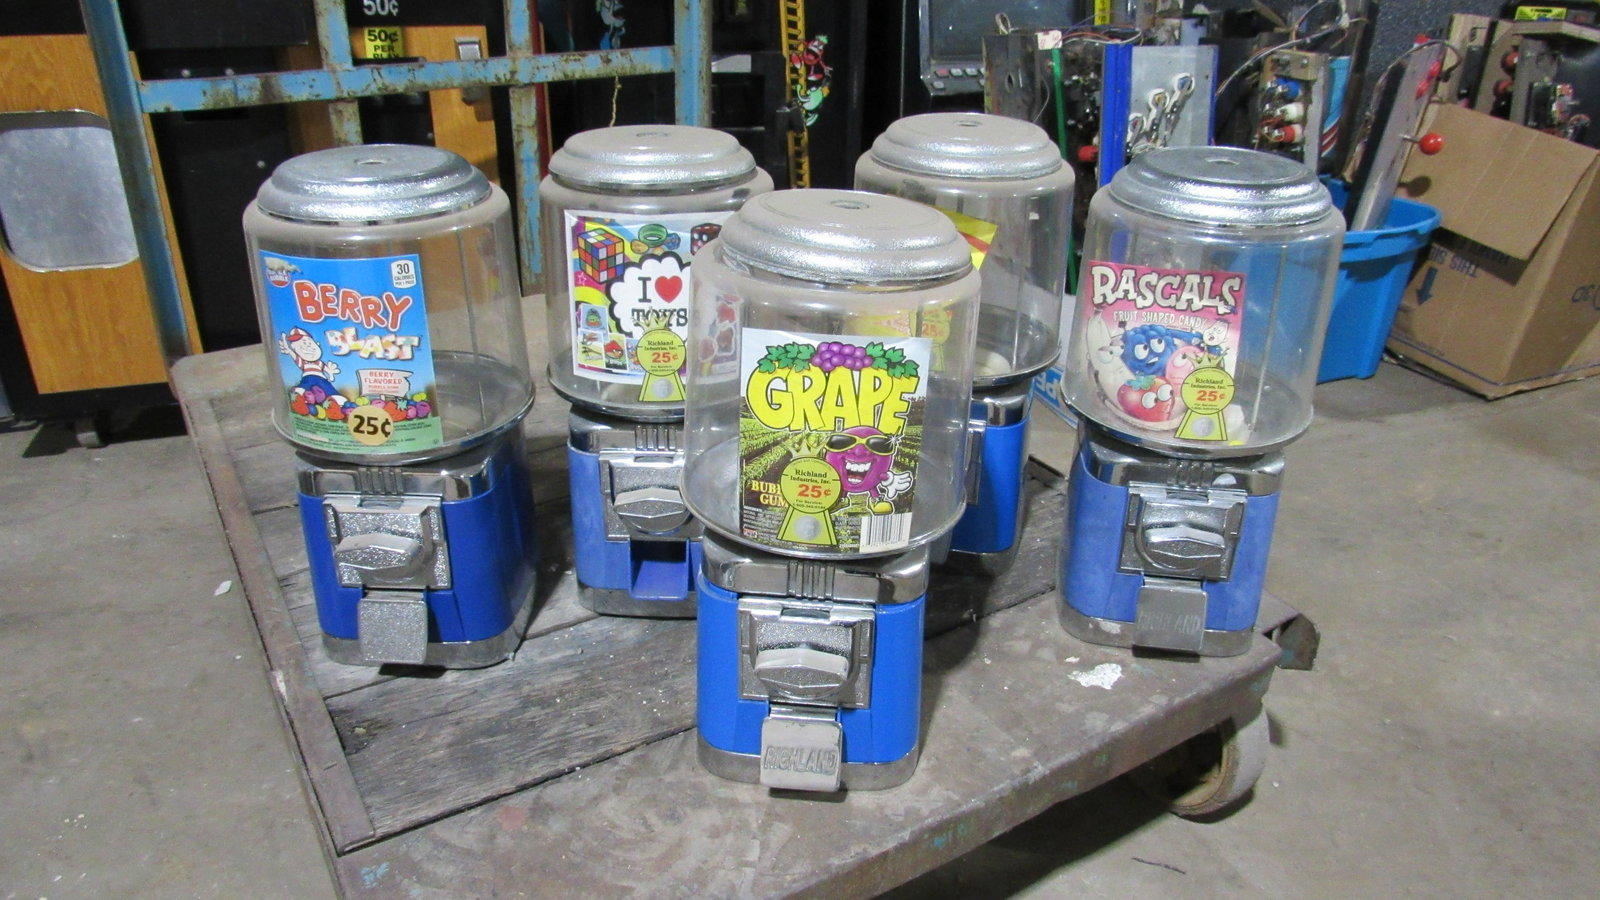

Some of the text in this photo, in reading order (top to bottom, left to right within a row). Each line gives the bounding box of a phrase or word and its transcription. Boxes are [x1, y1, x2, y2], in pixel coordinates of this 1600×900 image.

[363, 0, 399, 16] 50¢
[367, 29, 399, 44] 50¢
[373, 45, 395, 53] PER
[396, 263, 410, 275] 30
[638, 276, 652, 303] I
[1091, 265, 1242, 315] RASCALS
[293, 280, 412, 331] BERRY
[631, 308, 688, 327] TOYS
[1113, 311, 1208, 327] FRUIT SHAPED CANDY
[324, 327, 420, 360] BLAST
[746, 366, 920, 436] GRAPE
[1196, 390, 1226, 401] 25¢
[352, 415, 392, 438] 25¢
[795, 470, 827, 478] Richland
[798, 484, 831, 498] 25¢
[760, 493, 789, 508] GUM
[763, 745, 837, 775] RICHLAND
